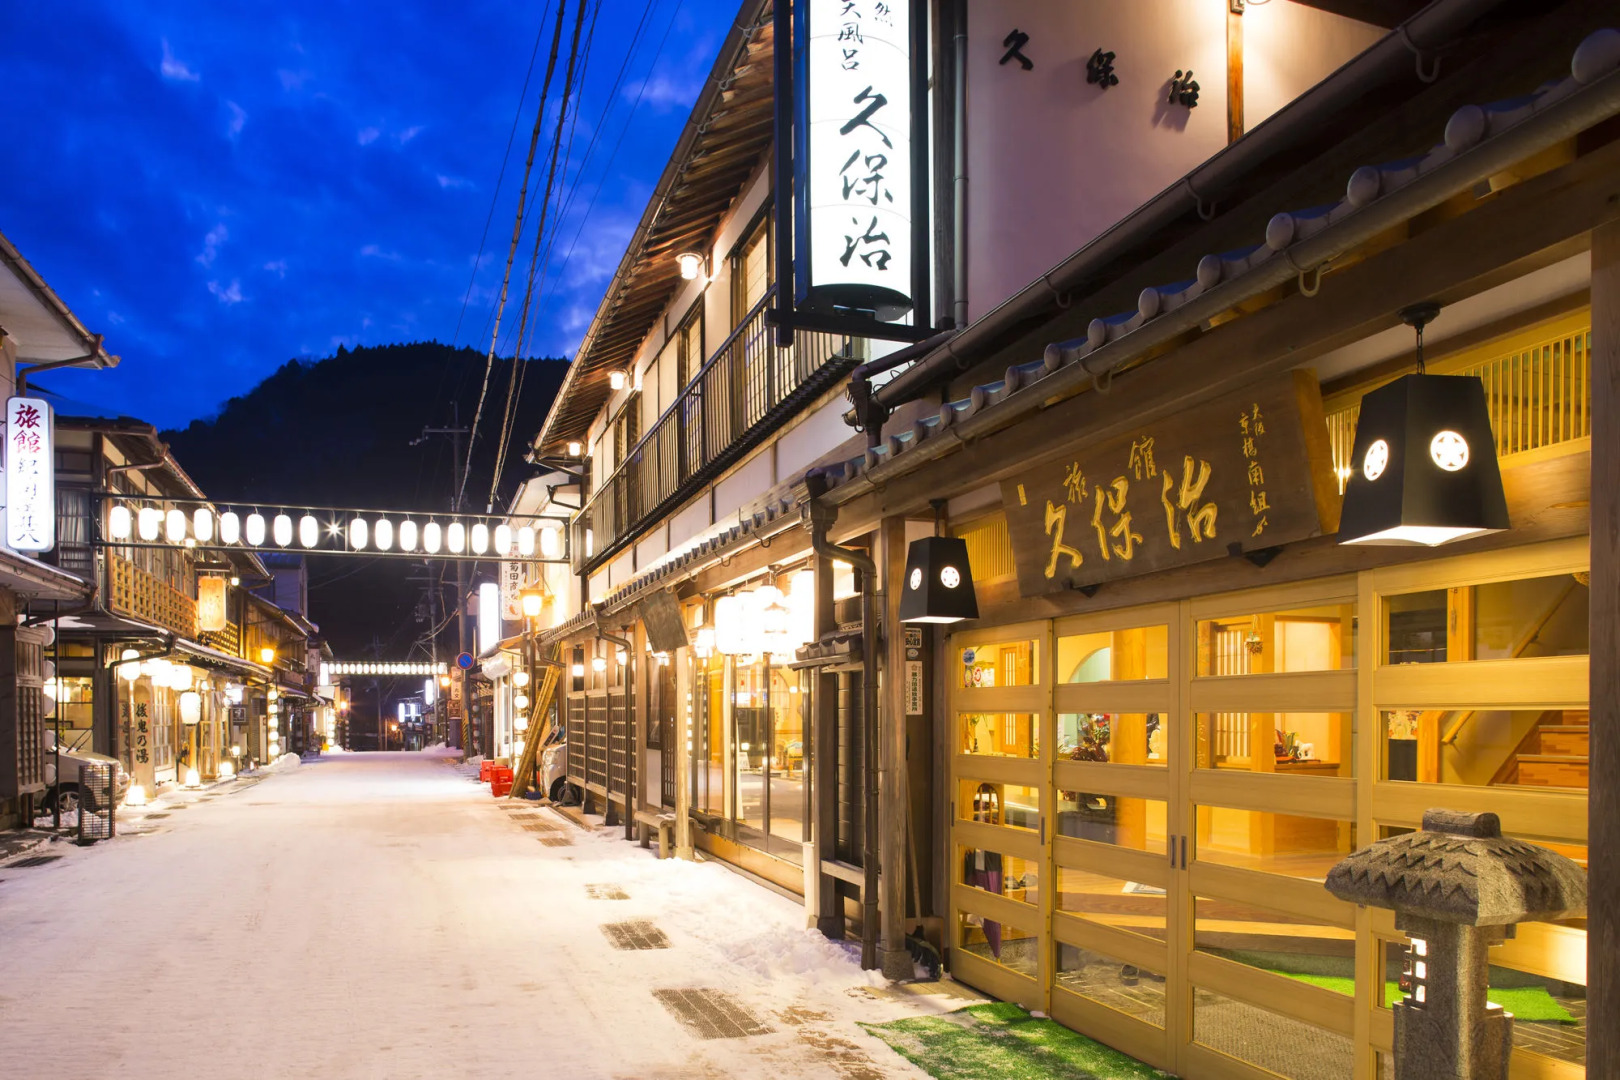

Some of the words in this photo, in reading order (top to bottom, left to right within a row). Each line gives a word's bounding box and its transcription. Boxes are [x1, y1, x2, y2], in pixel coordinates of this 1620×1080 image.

[998, 28, 1200, 108] 久保治
[838, 85, 894, 271] 久保治
[1044, 455, 1218, 579] 久保治
[1063, 435, 1157, 503] 旅館
